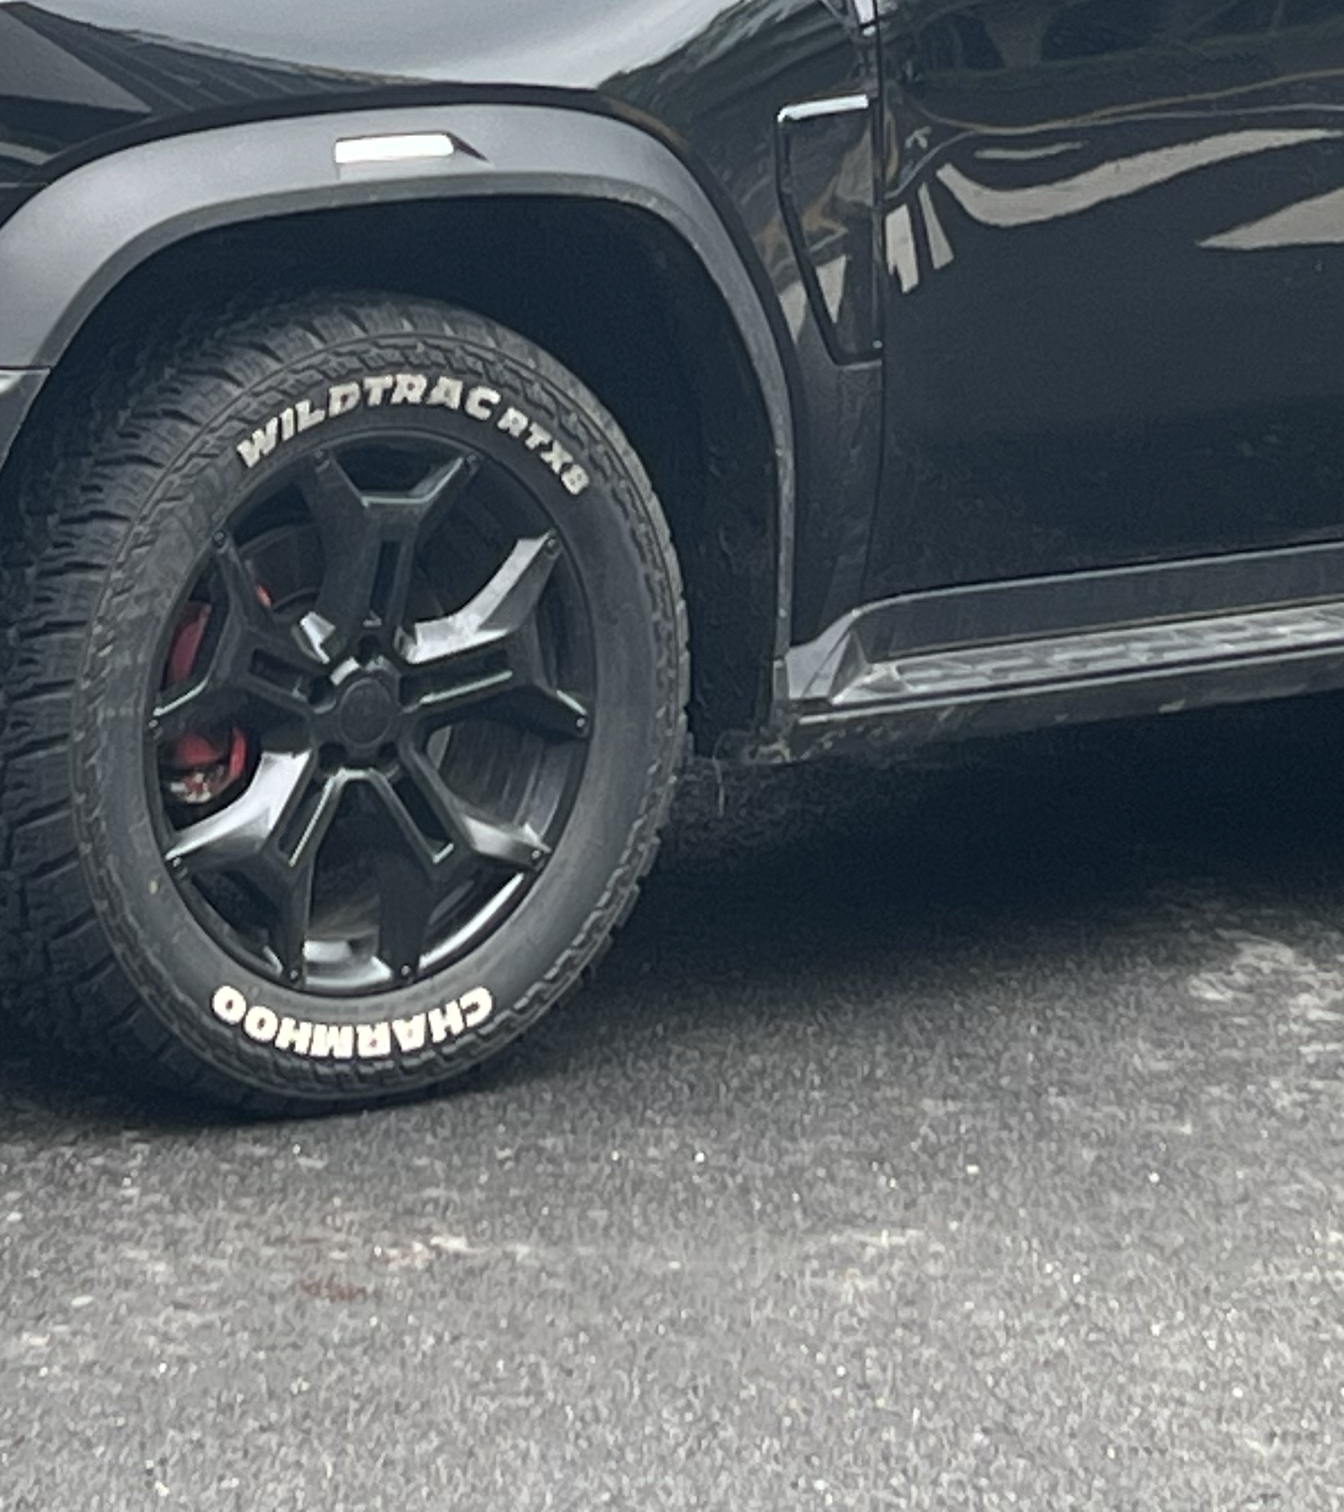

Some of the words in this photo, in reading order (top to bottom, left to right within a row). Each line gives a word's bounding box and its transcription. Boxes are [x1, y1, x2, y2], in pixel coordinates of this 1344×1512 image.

[236, 374, 502, 468] WILDTRAC
[496, 407, 590, 495] RTX8
[212, 985, 494, 1059] CHARMHOO
